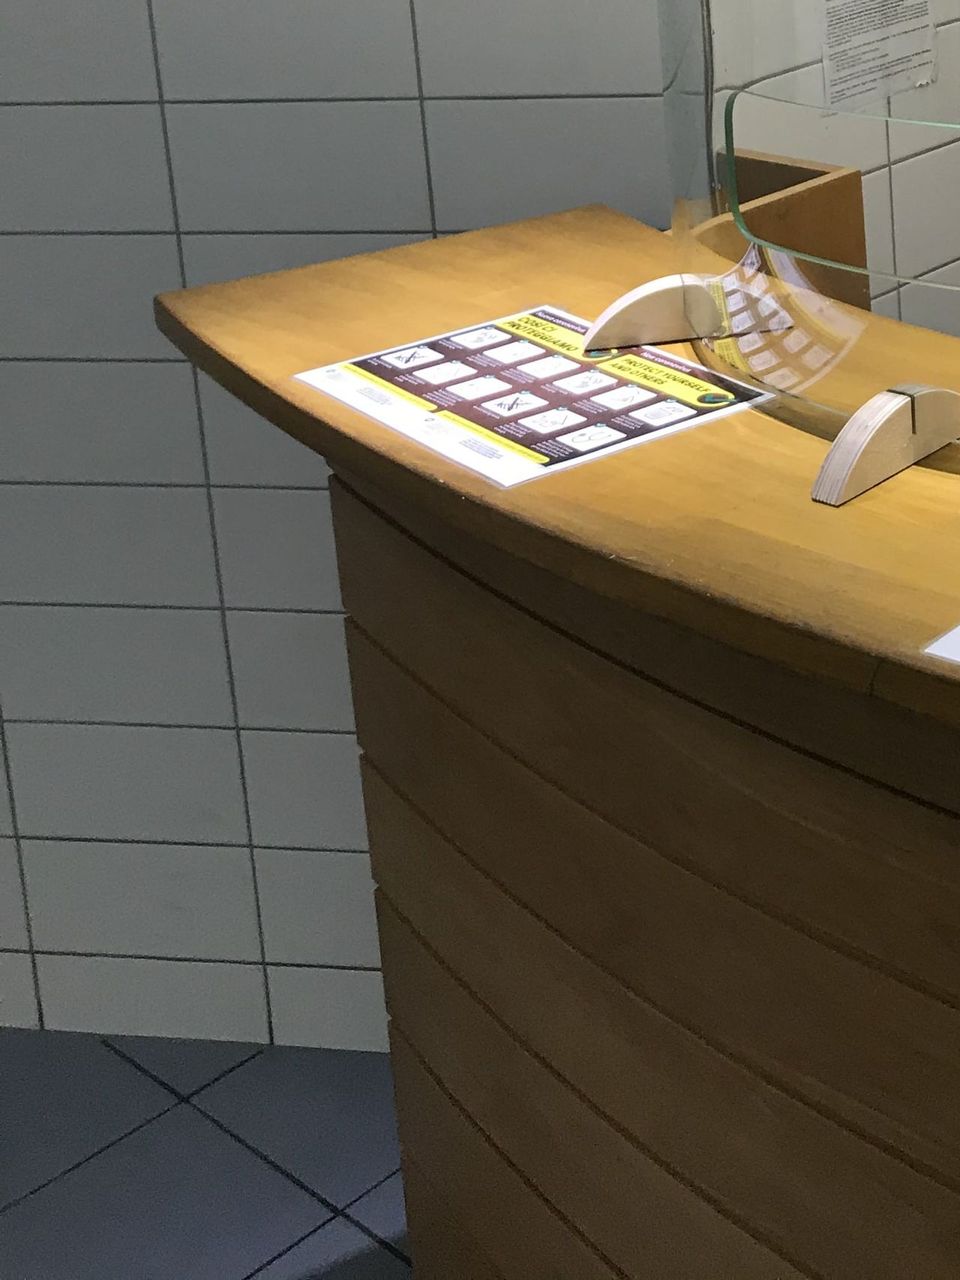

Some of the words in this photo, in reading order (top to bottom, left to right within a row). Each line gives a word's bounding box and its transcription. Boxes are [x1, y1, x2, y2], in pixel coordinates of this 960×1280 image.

[505, 321, 578, 351] PROTEGGIAMO
[611, 363, 632, 373] AND
[631, 370, 667, 385] OTHERS
[624, 358, 663, 375] PROTECT
[664, 372, 711, 392] YOURSELF
